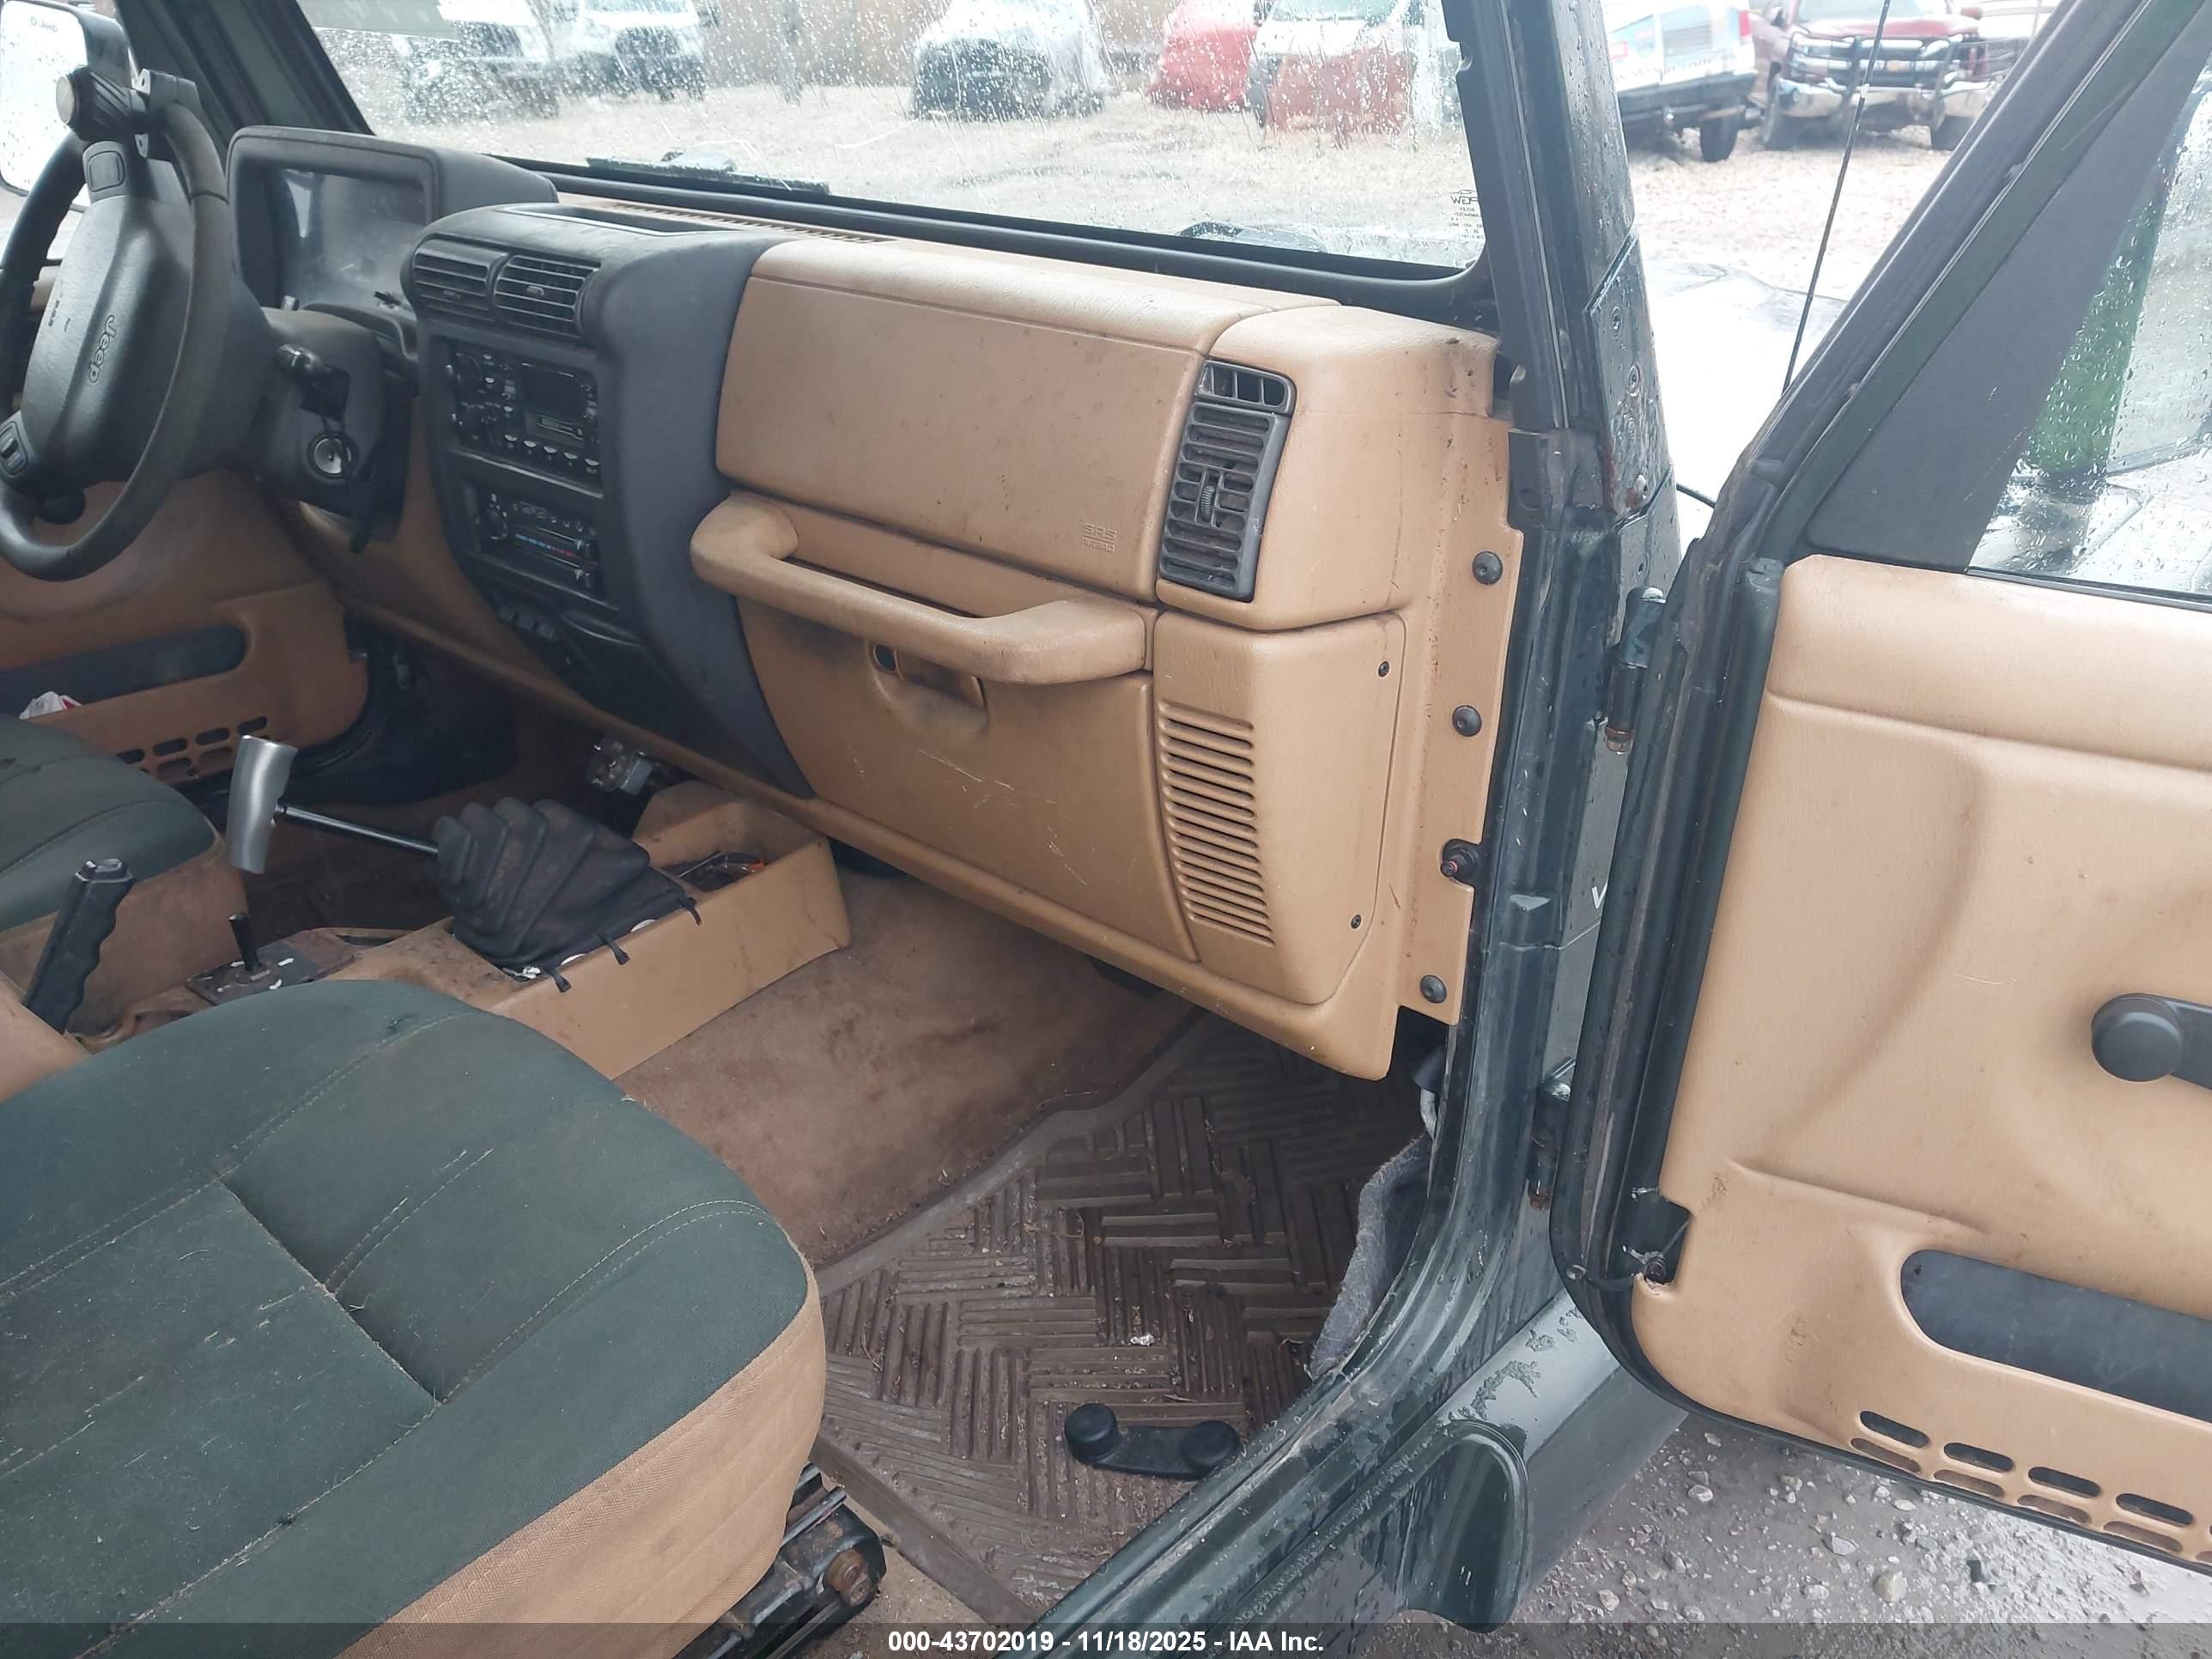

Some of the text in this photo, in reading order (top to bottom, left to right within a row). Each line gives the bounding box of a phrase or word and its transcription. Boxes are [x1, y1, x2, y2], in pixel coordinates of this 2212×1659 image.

[88, 314, 118, 383] Jeep
[1083, 522, 1117, 541] SRS
[1082, 537, 1115, 554] AIRBAG
